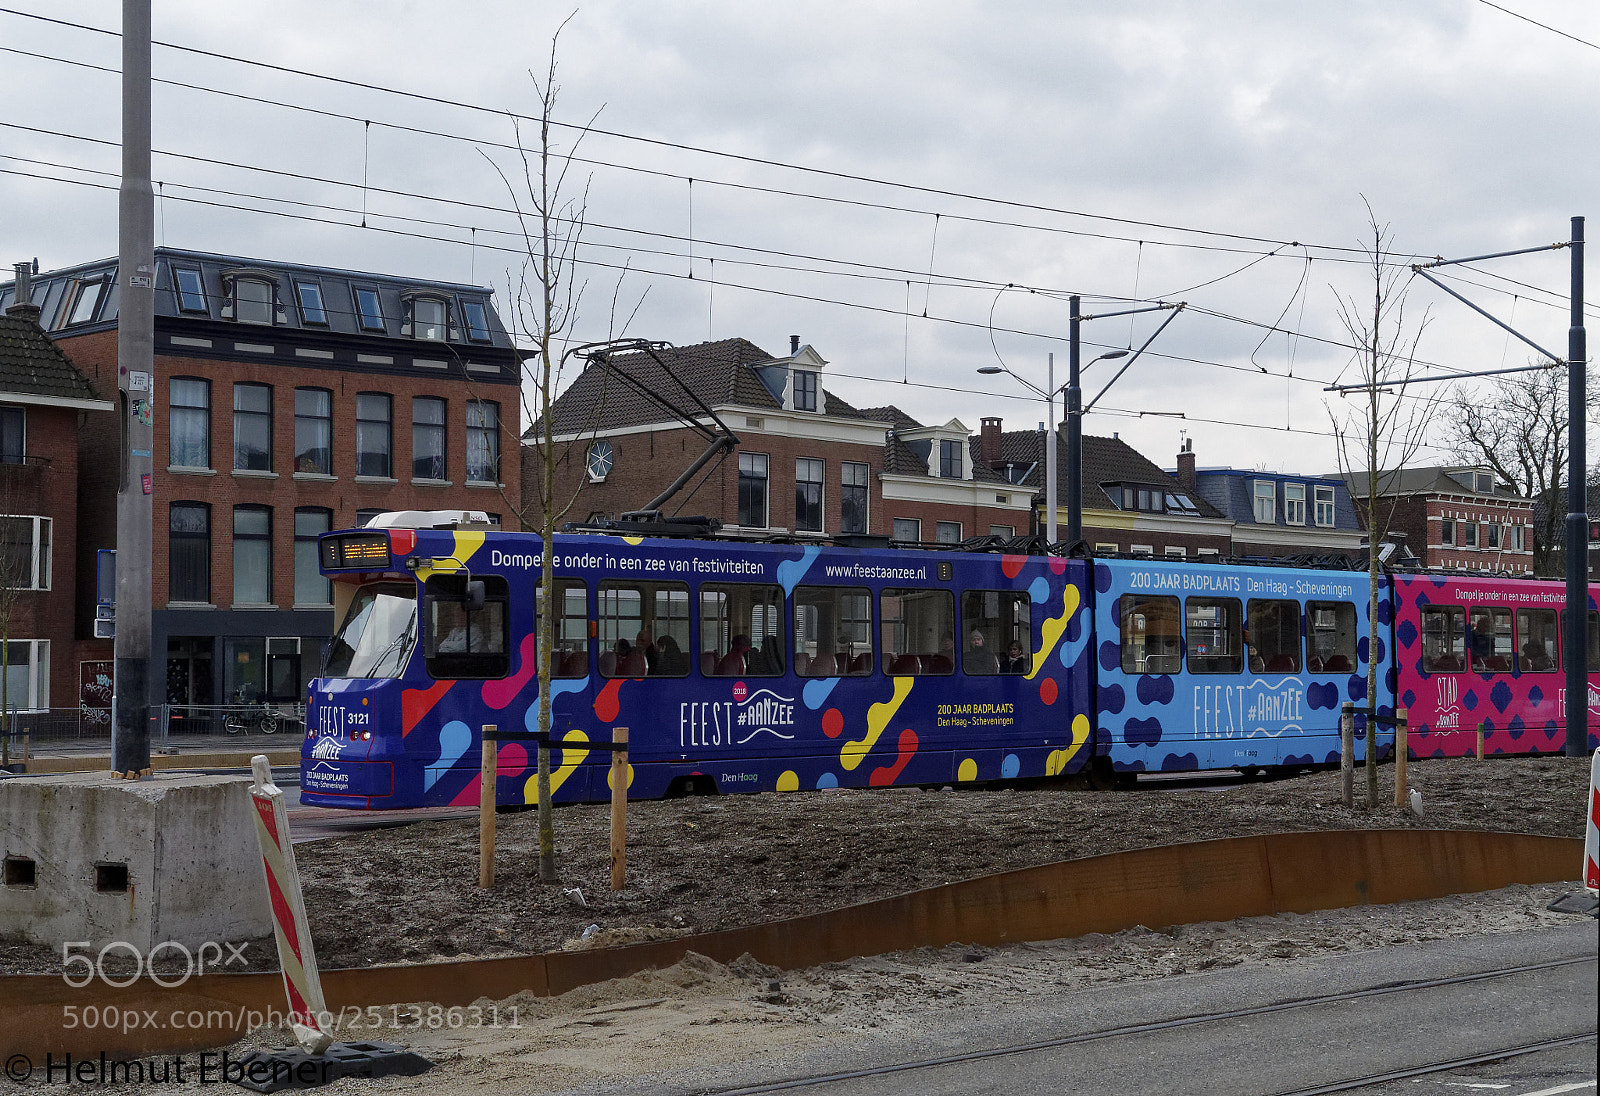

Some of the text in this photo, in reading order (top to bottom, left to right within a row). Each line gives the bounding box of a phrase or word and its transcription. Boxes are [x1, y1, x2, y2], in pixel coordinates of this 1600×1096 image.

[564, 552, 603, 569] onder
[605, 553, 617, 569] in
[620, 557, 642, 570] een
[644, 558, 666, 571] zee
[668, 559, 690, 573] van
[692, 557, 764, 575] festiviteiten
[825, 563, 927, 580] www.feestaanzee.nl
[1130, 572, 1151, 588] 200
[1153, 573, 1181, 589] JAAR
[1183, 574, 1240, 592] BADPLAATS
[1247, 577, 1264, 592] Den
[1266, 578, 1288, 596] Haag
[1296, 579, 1353, 598] Scheveningen
[1455, 588, 1478, 602] Dompel
[1478, 589, 1484, 602] je
[1484, 590, 1501, 601] onder
[1501, 590, 1507, 601] in
[1508, 593, 1519, 602] een
[1519, 593, 1530, 602] zee
[733, 687, 747, 695] 2018
[1437, 676, 1458, 708] STAD
[937, 703, 1014, 715] 200 JAAR BADPLAATS
[1193, 685, 1303, 739] FEEST #AANZEE
[319, 706, 346, 740] FEEST
[347, 713, 369, 724] 3121
[680, 698, 794, 747] FEEST #AANZEE
[937, 717, 951, 727] Den
[951, 716, 967, 728] Haag
[972, 715, 1014, 727] Scheveningen
[321, 773, 349, 782] BADPLAATS
[721, 773, 737, 783] Den
